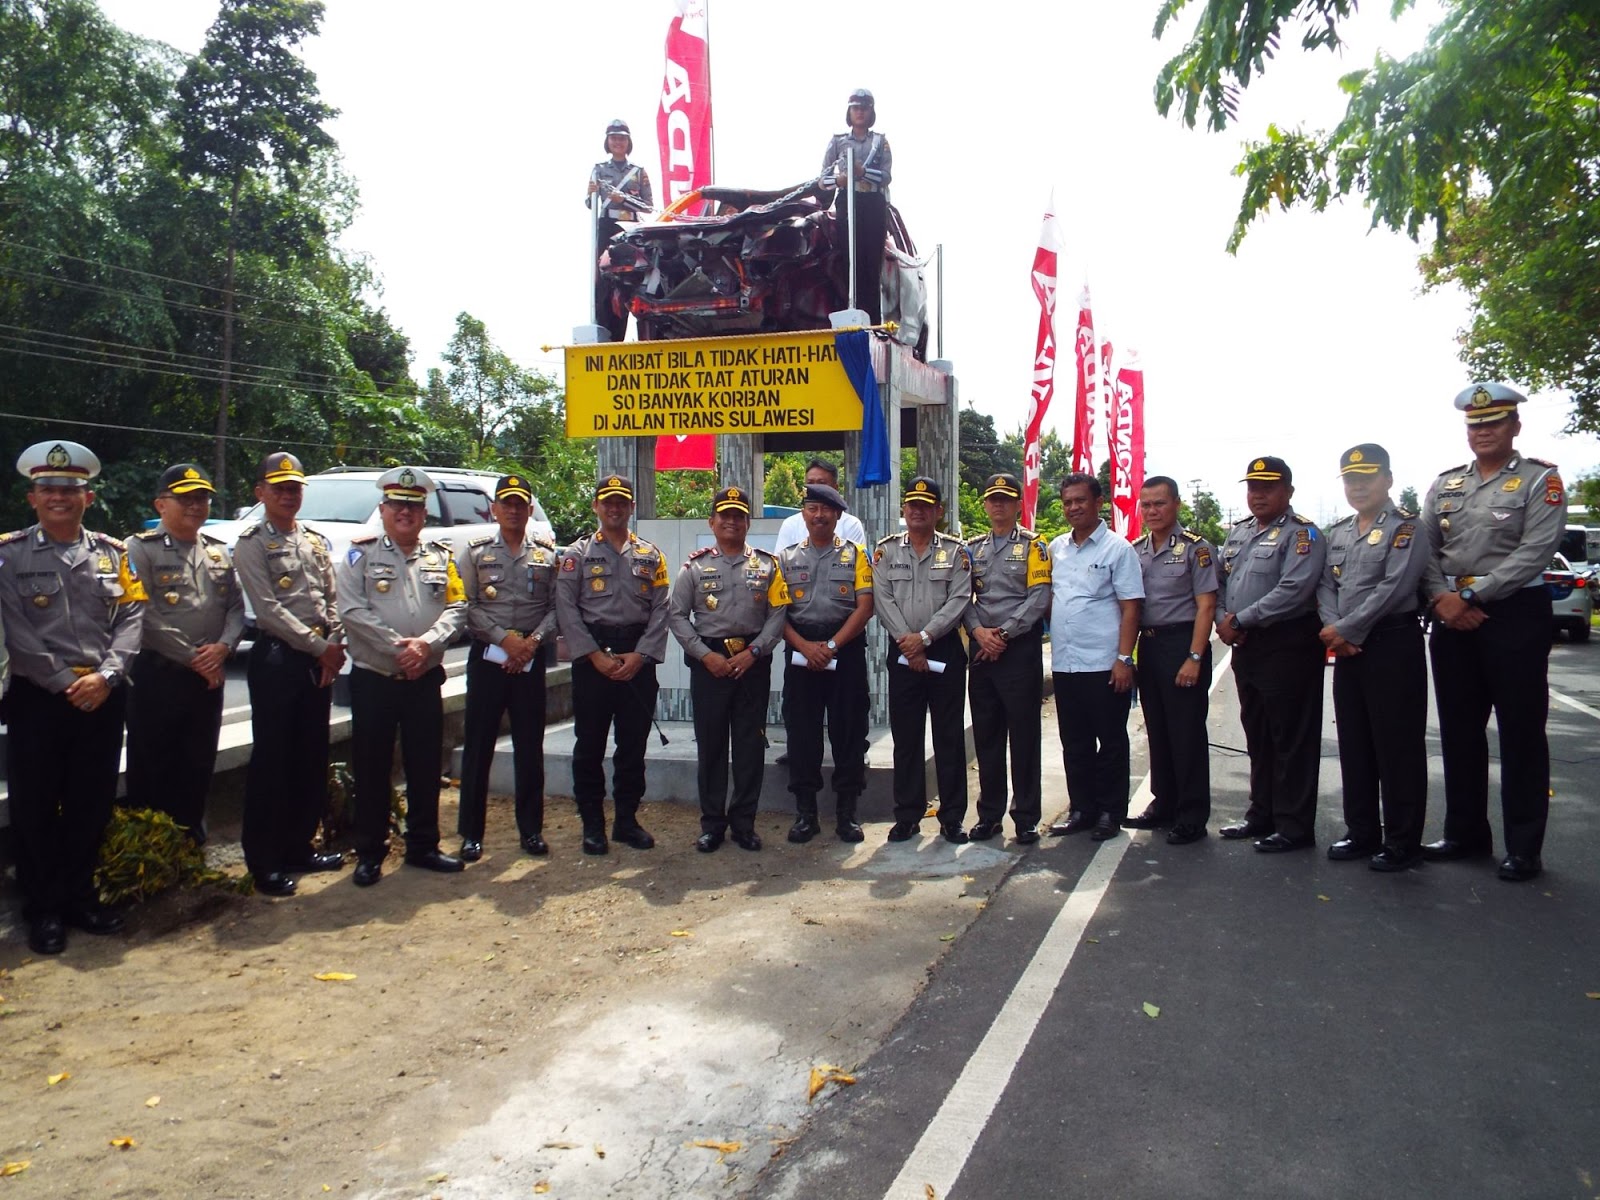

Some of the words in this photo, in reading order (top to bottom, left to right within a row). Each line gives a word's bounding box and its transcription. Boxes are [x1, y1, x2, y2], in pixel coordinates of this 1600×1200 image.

[585, 354, 604, 372] INI
[608, 352, 664, 371] AKIBAT
[667, 350, 705, 369] BILA
[709, 348, 759, 367] TIDAK
[763, 344, 839, 365] HATI-HAT
[607, 373, 641, 391] DAN
[644, 371, 692, 389] TIDAK
[695, 370, 735, 388] TAAT
[740, 367, 809, 387] ATURAN
[612, 394, 635, 410] SO
[638, 391, 705, 410] BANYAK
[708, 389, 780, 408] KORBAN
[593, 414, 609, 430] DI
[612, 412, 665, 430] JALAN
[668, 410, 725, 429] TRANS
[728, 408, 815, 427] SULAWESI
